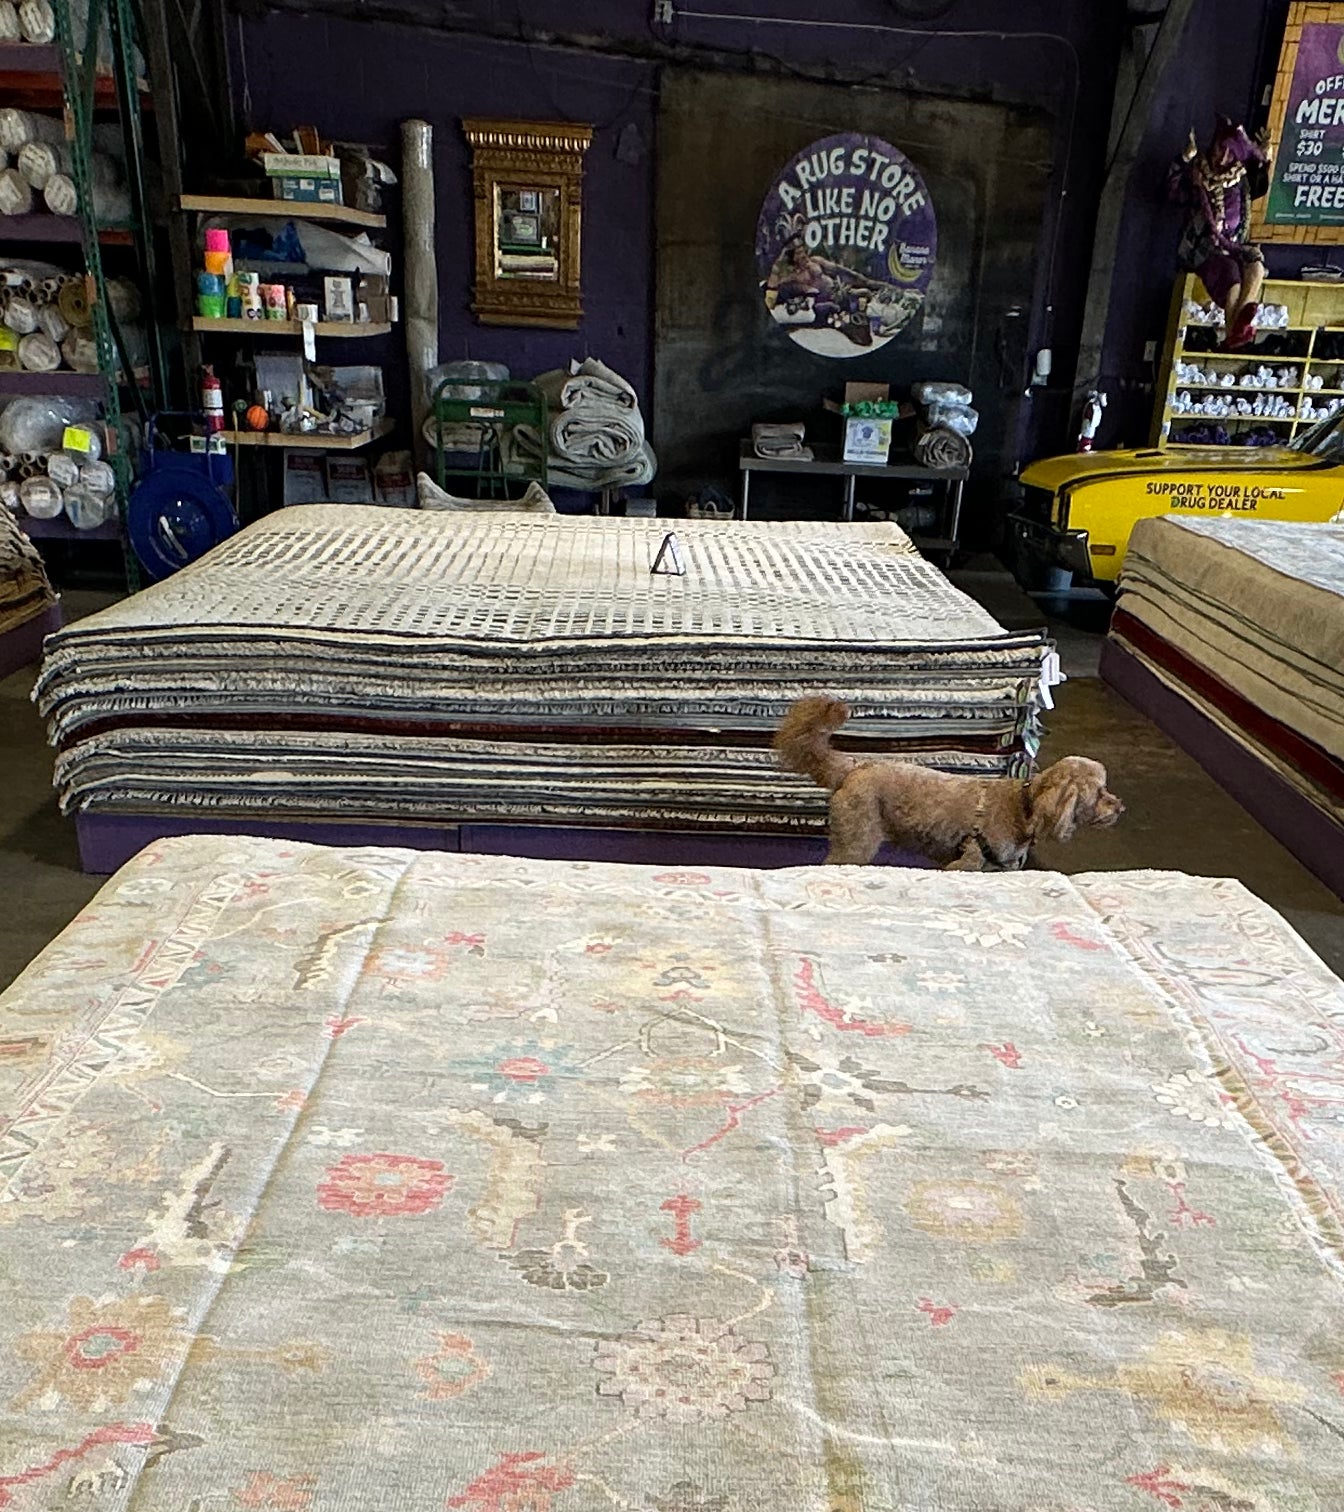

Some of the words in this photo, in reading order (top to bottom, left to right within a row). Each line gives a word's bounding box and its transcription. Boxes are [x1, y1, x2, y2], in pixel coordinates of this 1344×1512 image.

[1296, 140, 1323, 157] $30
[778, 181, 802, 210] A
[796, 147, 846, 189] RUG
[849, 148, 926, 217] STORE
[805, 187, 855, 219] LIKE
[860, 189, 896, 222] NO
[805, 217, 889, 252] OTHER
[1145, 482, 1203, 497] SUPPORT
[1207, 484, 1240, 498] YOUR
[1243, 486, 1286, 500] LOCAL
[1170, 496, 1206, 509] DRUG
[1208, 498, 1258, 511] DEALER
